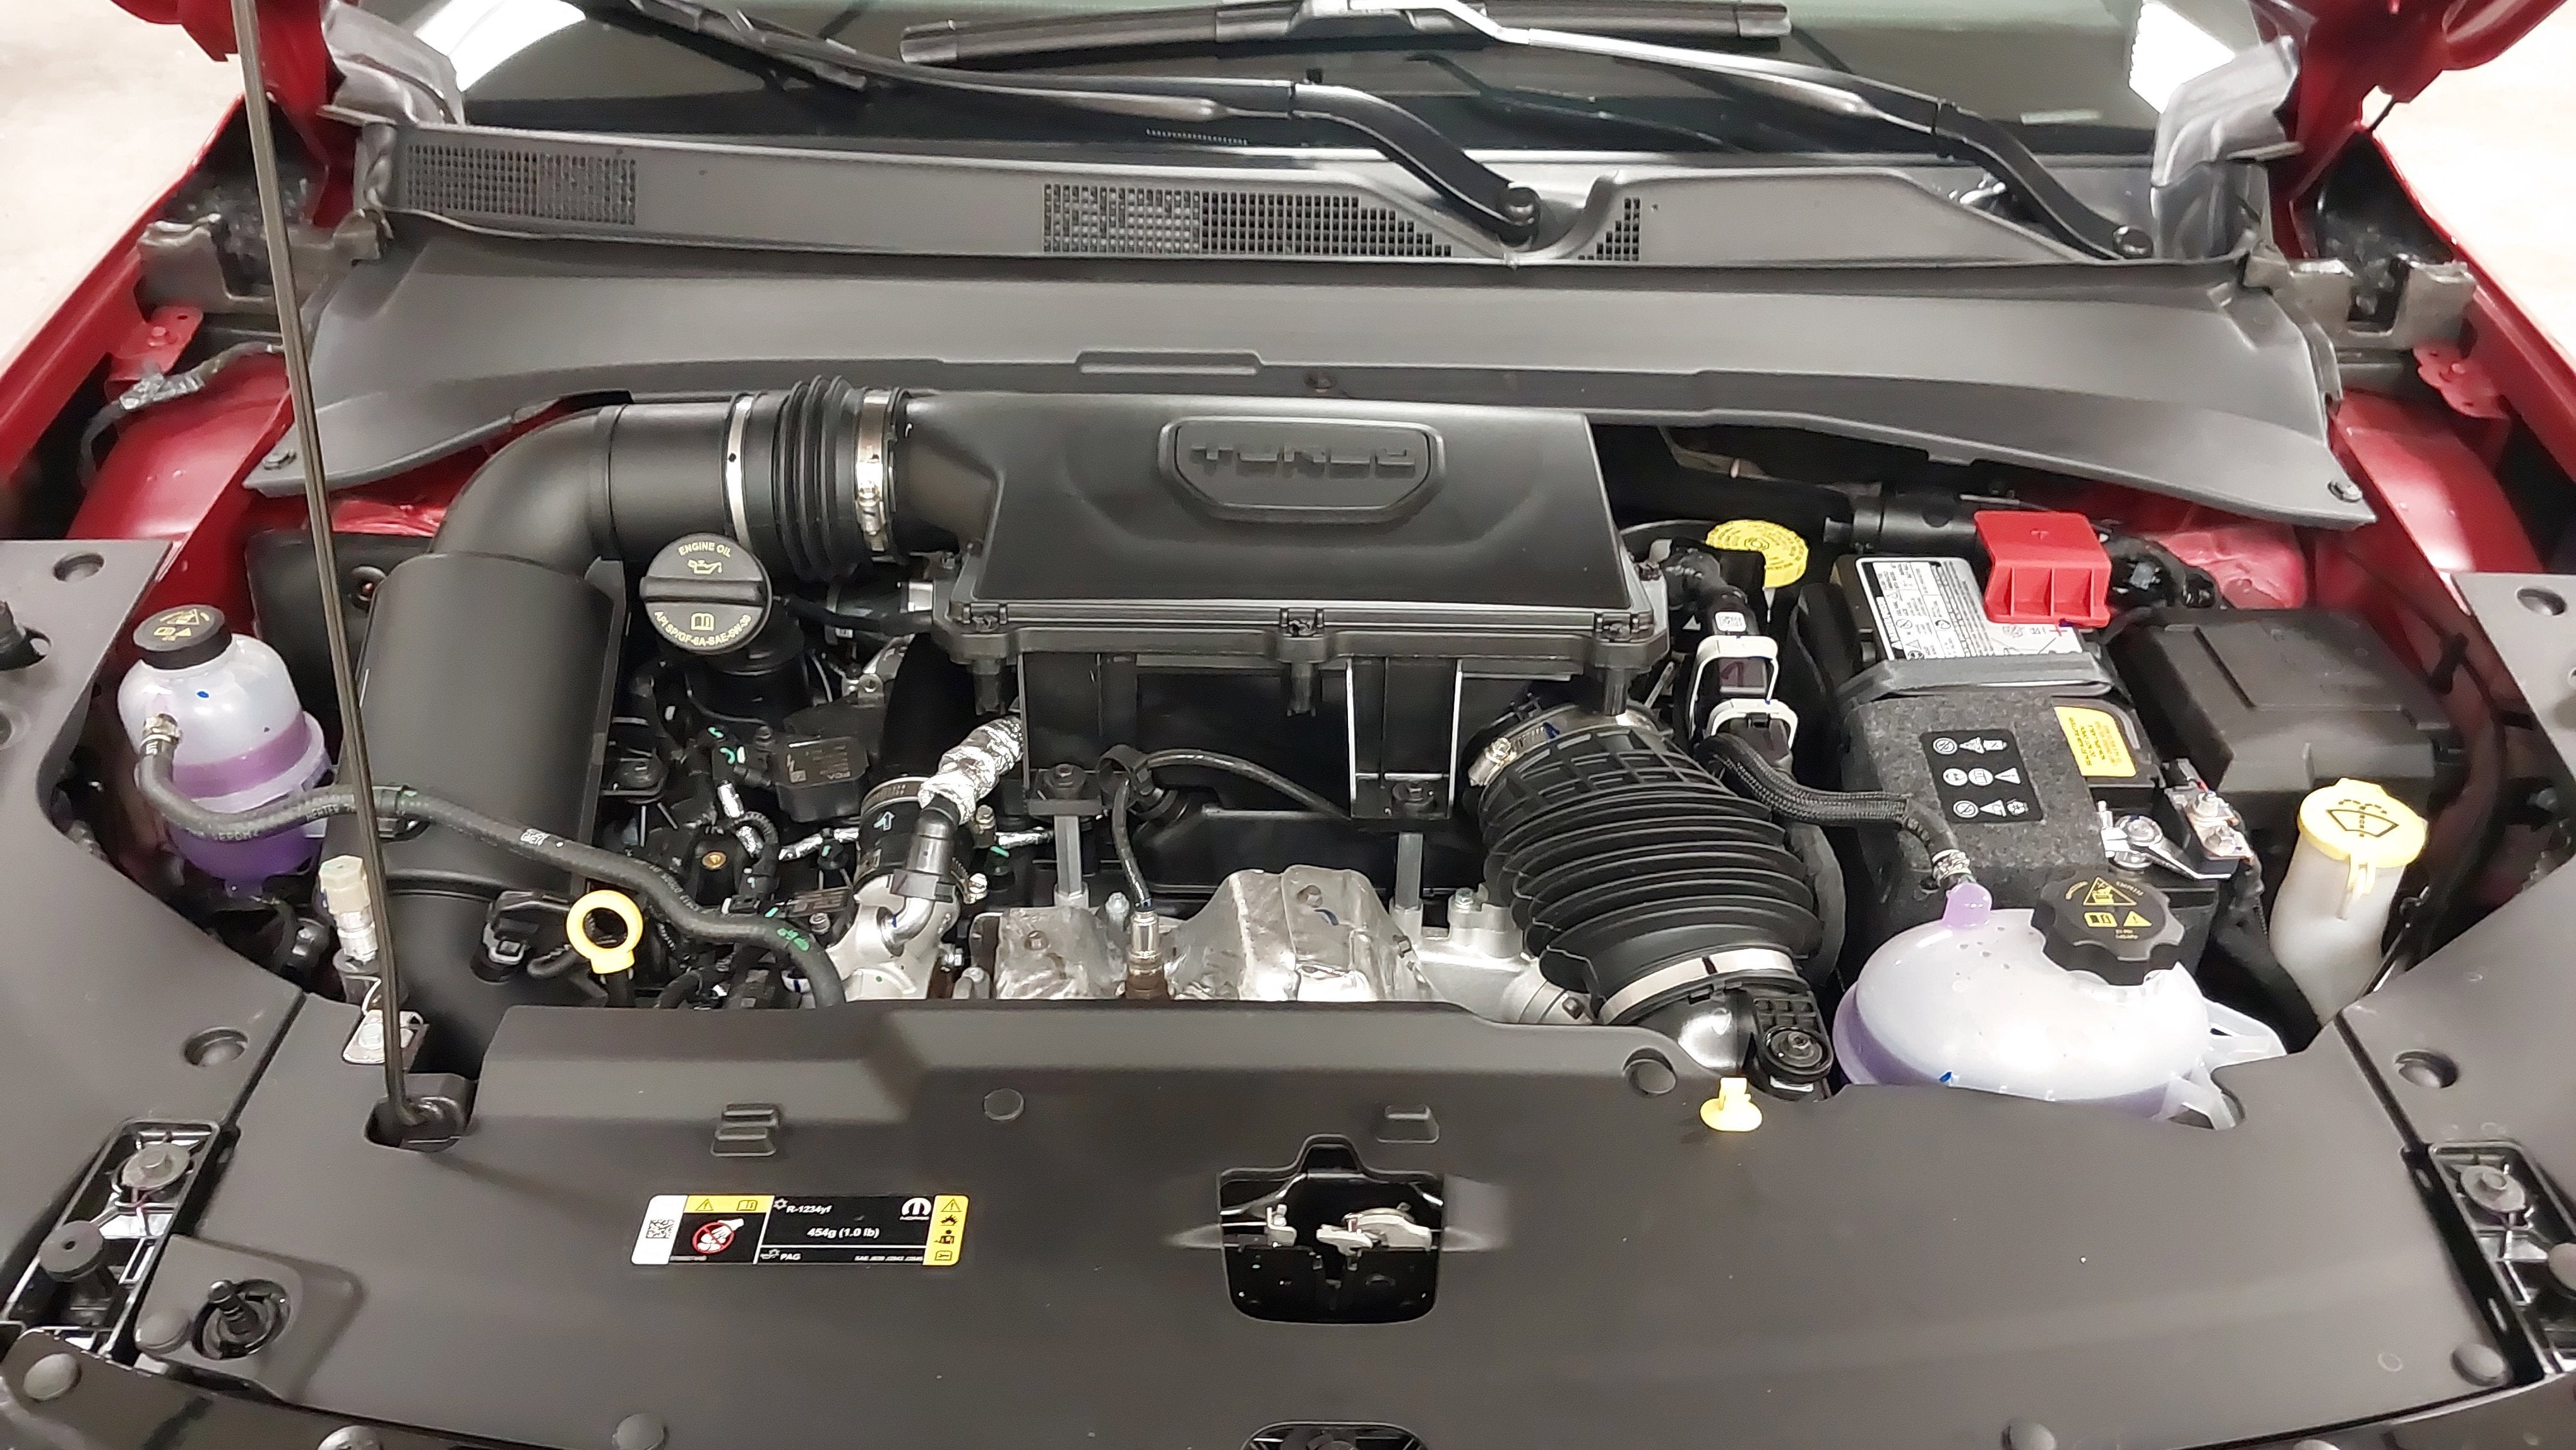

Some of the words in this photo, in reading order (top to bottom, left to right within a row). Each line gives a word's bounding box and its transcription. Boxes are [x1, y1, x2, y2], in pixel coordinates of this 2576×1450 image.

[678, 542, 715, 556] ENGINE
[717, 544, 731, 558] OIL
[654, 611, 669, 626] API
[786, 1205, 833, 1214] R-1234yf
[806, 1228, 837, 1238] 454g
[863, 1228, 880, 1238] lb)
